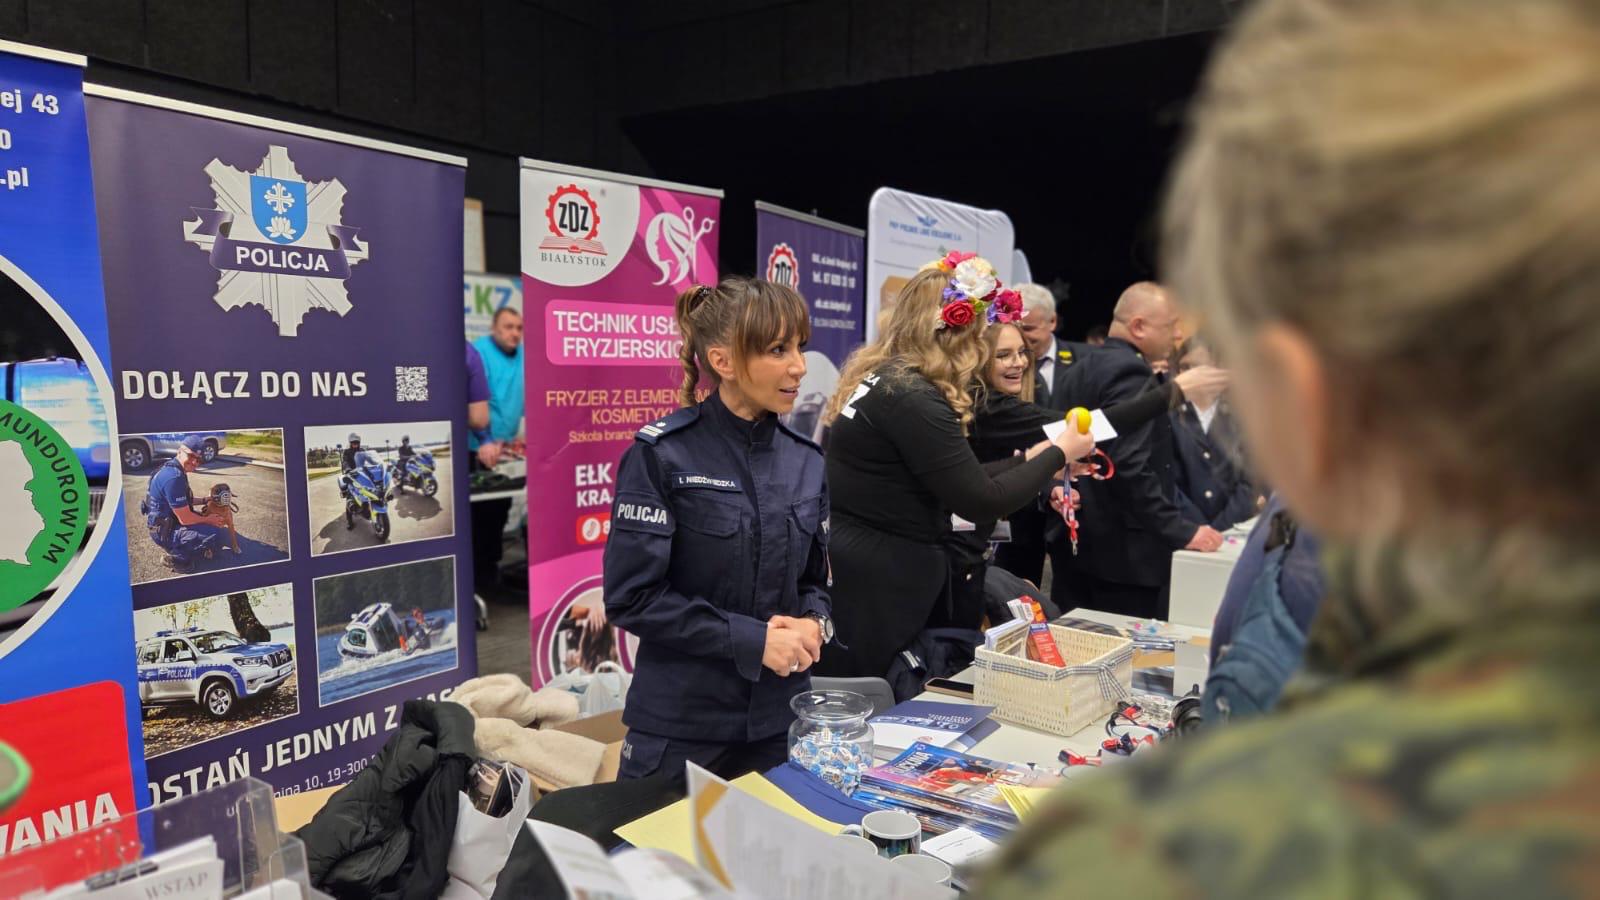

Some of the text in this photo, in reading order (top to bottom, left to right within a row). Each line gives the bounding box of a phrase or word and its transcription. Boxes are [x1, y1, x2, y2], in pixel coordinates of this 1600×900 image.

[31, 93, 59, 115] 43
[559, 200, 589, 232] ZDZ
[236, 246, 330, 272] POLICJA
[541, 252, 606, 267] BIAŁYSTOK
[553, 311, 638, 334] TECHNIK
[121, 370, 367, 405] DOŁĄCZ DO NAS
[546, 391, 608, 407] FRYZJER
[612, 390, 621, 405] Z
[568, 430, 602, 443] Szkoła
[576, 462, 612, 486] EŁK
[618, 503, 668, 525] POLICJA
[166, 668, 193, 680] POLICJA
[261, 713, 376, 773] JEDNYM
[384, 705, 398, 732] Z
[304, 775, 324, 792] 10,
[327, 758, 368, 783] 19-300
